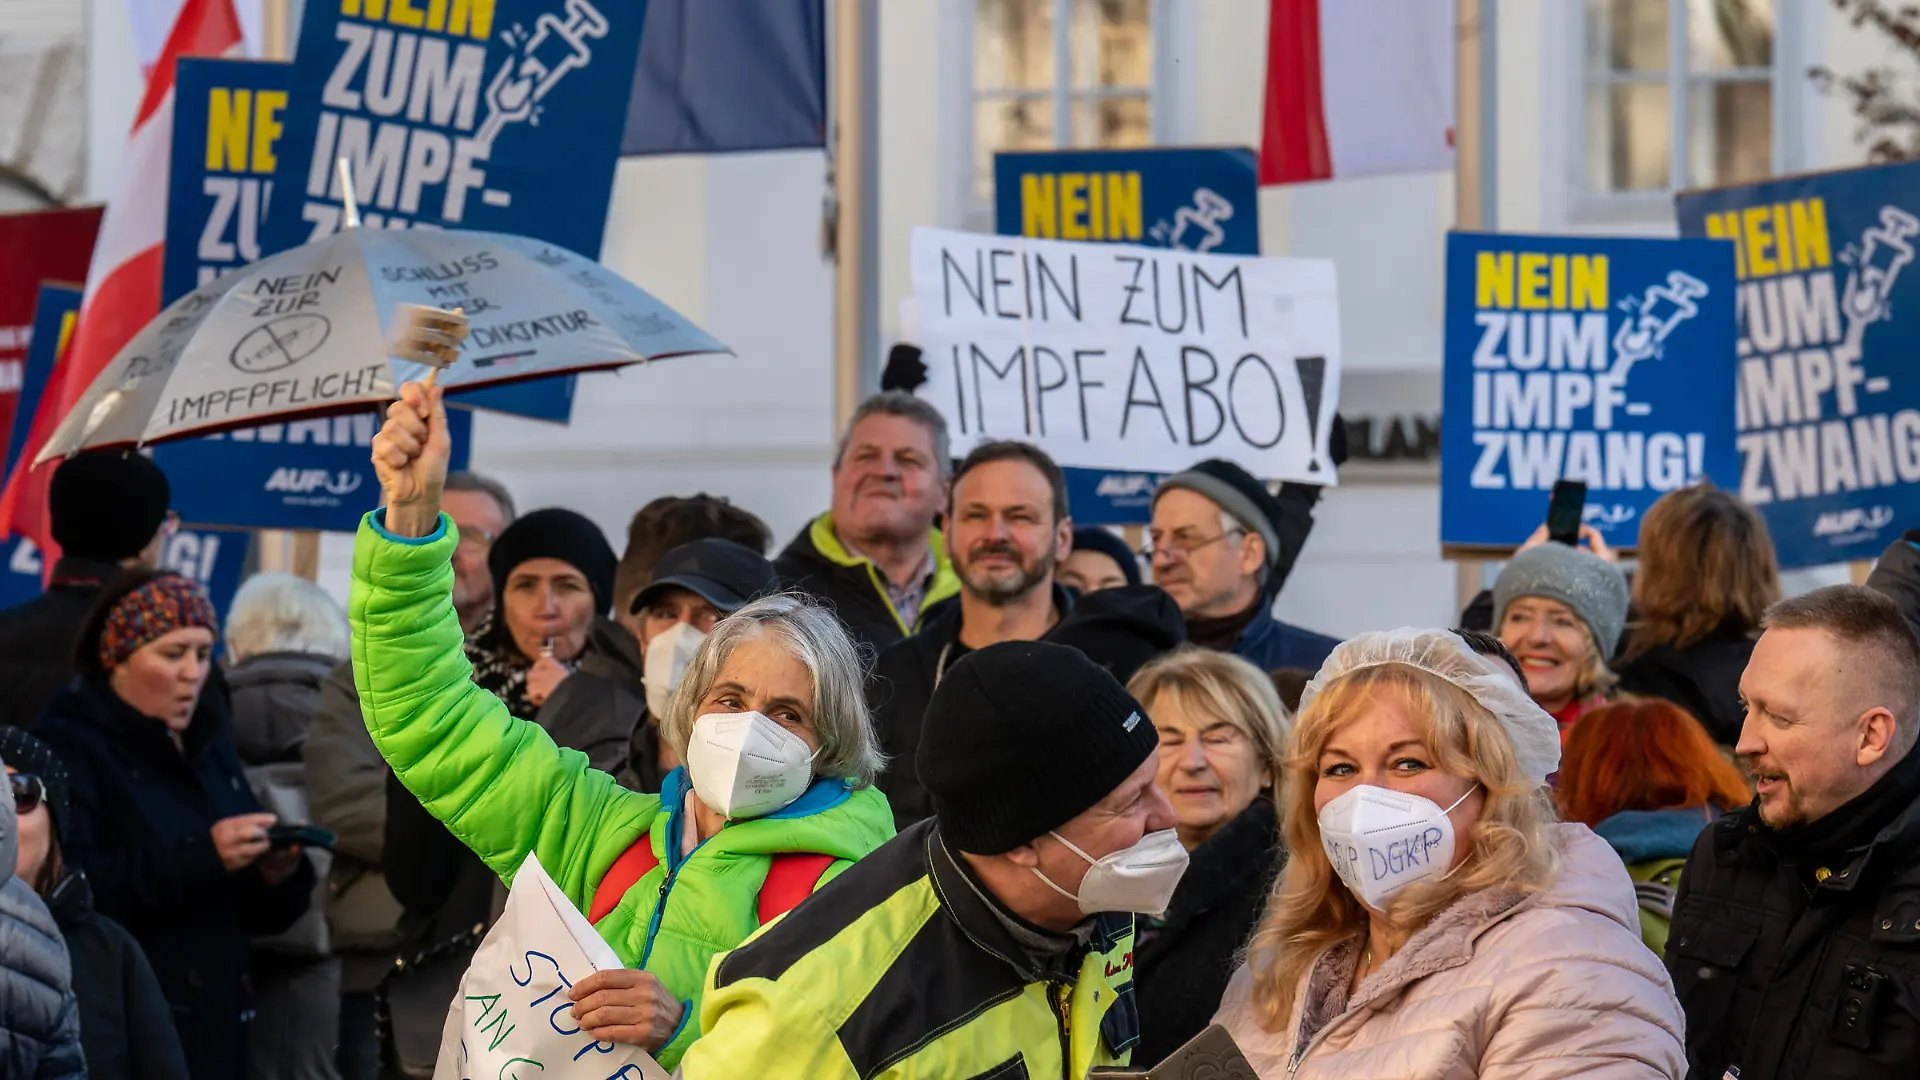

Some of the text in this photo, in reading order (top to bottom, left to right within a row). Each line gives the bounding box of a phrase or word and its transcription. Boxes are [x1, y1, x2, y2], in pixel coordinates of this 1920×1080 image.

[322, 22, 487, 131] ZUM
[206, 88, 288, 173] NE
[306, 111, 512, 223] IMPF-
[197, 176, 274, 261] ZU
[1021, 171, 1143, 239] NEIN
[253, 266, 343, 296] NEIN
[380, 251, 500, 283] SCHLUSS
[426, 281, 470, 300] MIT
[941, 248, 1249, 339] NEIN ZUM
[1475, 251, 1609, 311] NEIN
[251, 290, 321, 318] ZUR
[1472, 311, 1609, 371] ZUM
[168, 363, 387, 424] IMPFPFLICHT
[1472, 371, 1653, 430] IMPF-
[1469, 431, 1706, 491] ZWANG!
[1368, 827, 1443, 881] DGKP
